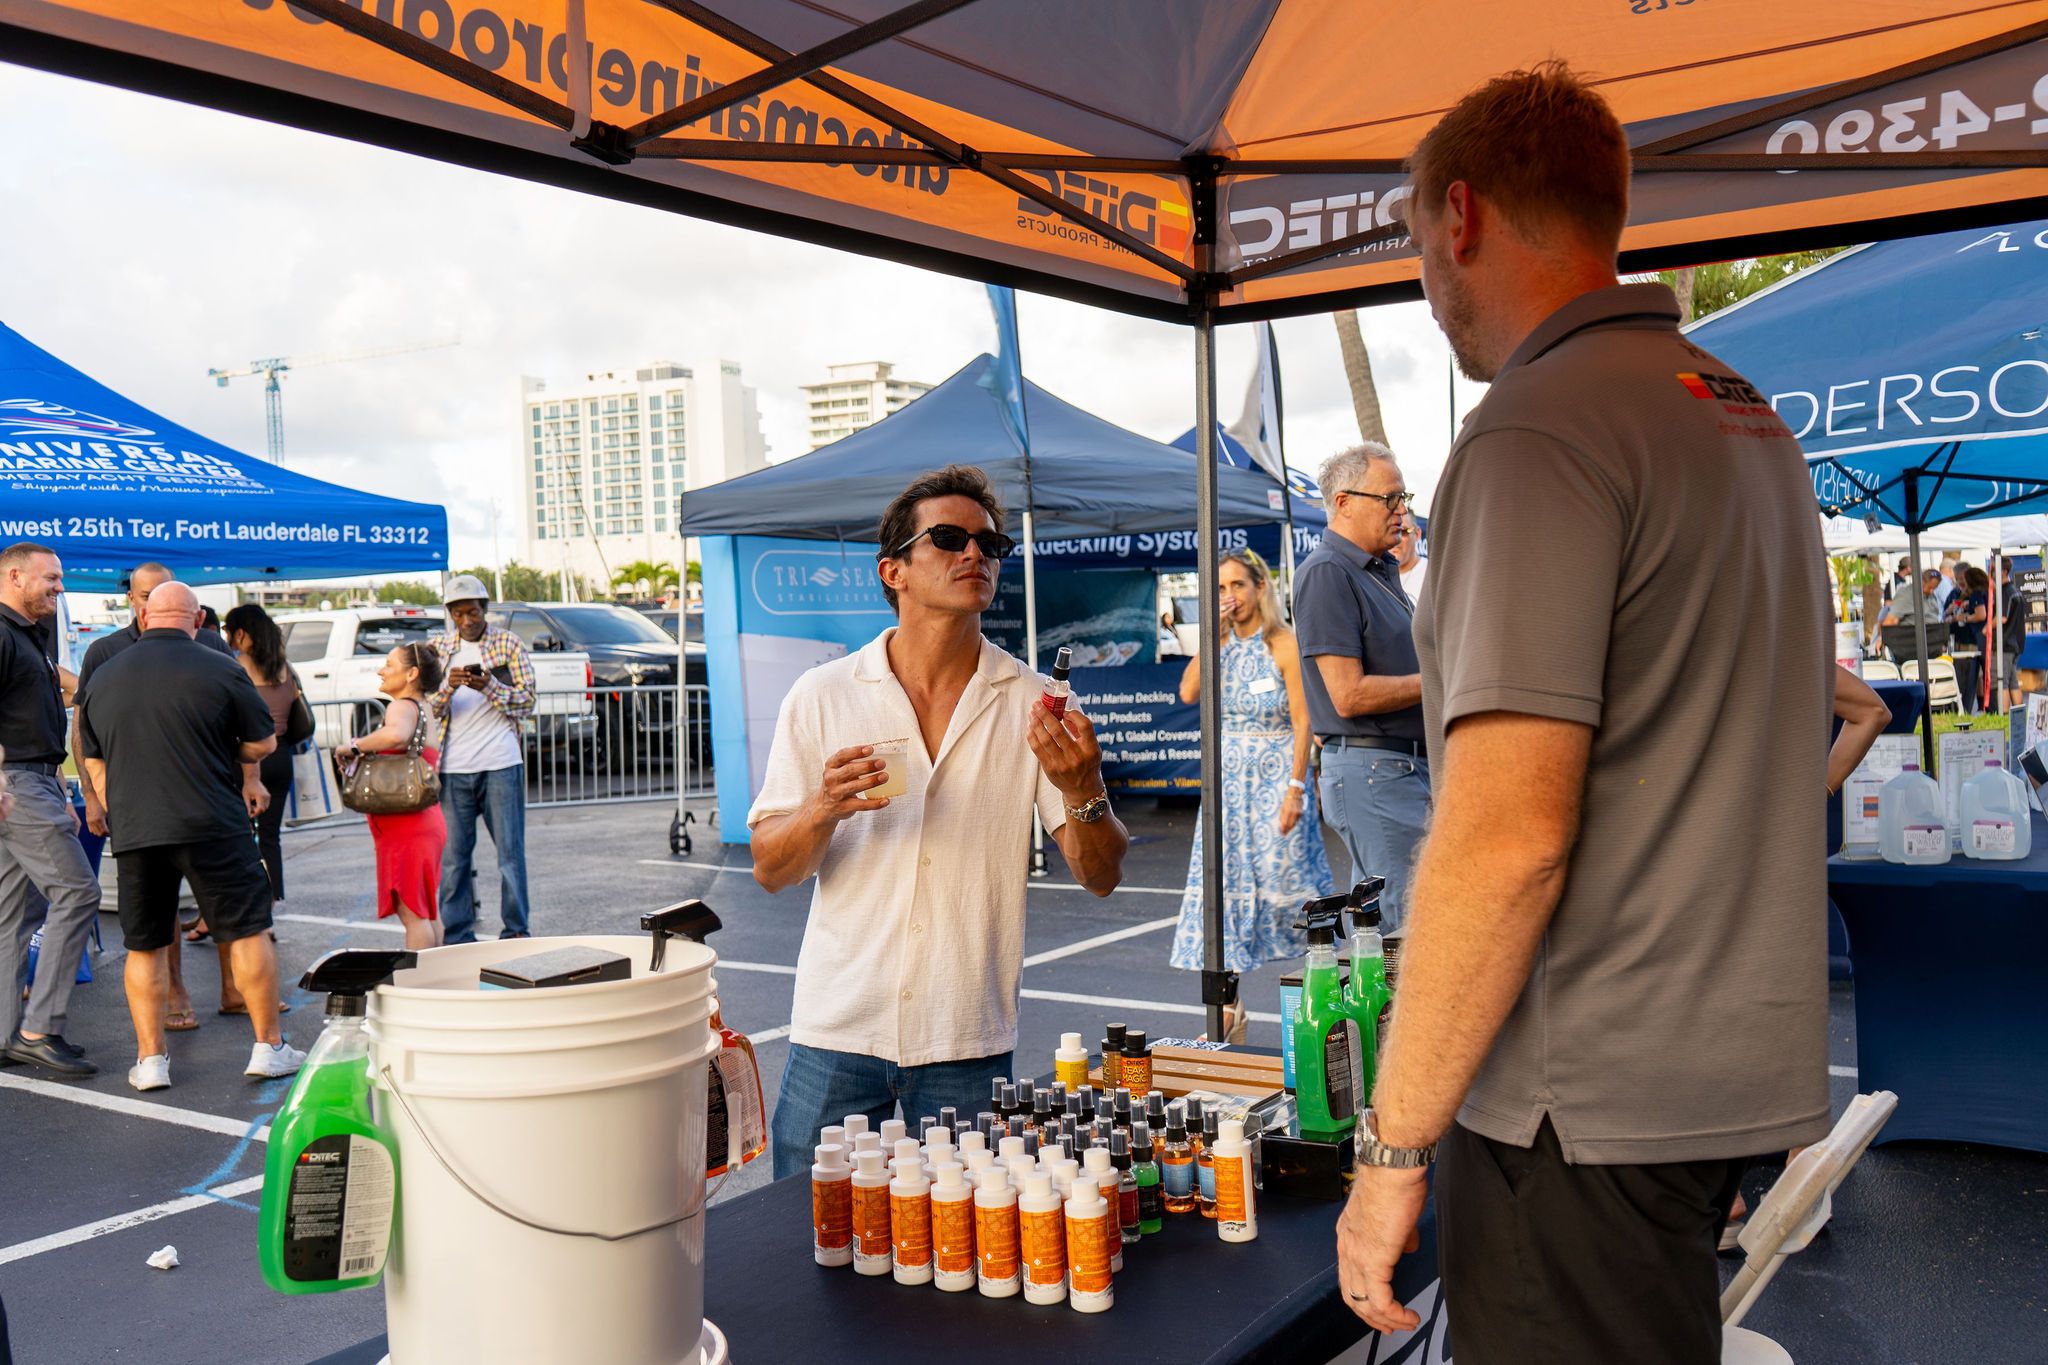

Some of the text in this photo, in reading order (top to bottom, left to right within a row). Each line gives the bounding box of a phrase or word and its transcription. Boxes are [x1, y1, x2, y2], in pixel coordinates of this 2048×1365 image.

[123, 459, 246, 481] CENTER
[11, 482, 87, 493] Shipyard
[90, 483, 122, 492] with
[140, 483, 202, 494] Marina
[154, 475, 266, 489] SERVICES
[0, 517, 430, 545] west 25th Ter, Fort Lauderdale FL 33312
[773, 565, 878, 588] TRI SEA
[1102, 692, 1134, 705] Marine
[1135, 690, 1176, 705] Decking
[1109, 711, 1153, 724] Products
[1125, 729, 1157, 743] Global
[1157, 729, 1201, 743] Coverag
[1120, 749, 1158, 764] Repairs
[1123, 1065, 1145, 1075] TEAK
[1122, 1073, 1147, 1084] MAGIC
